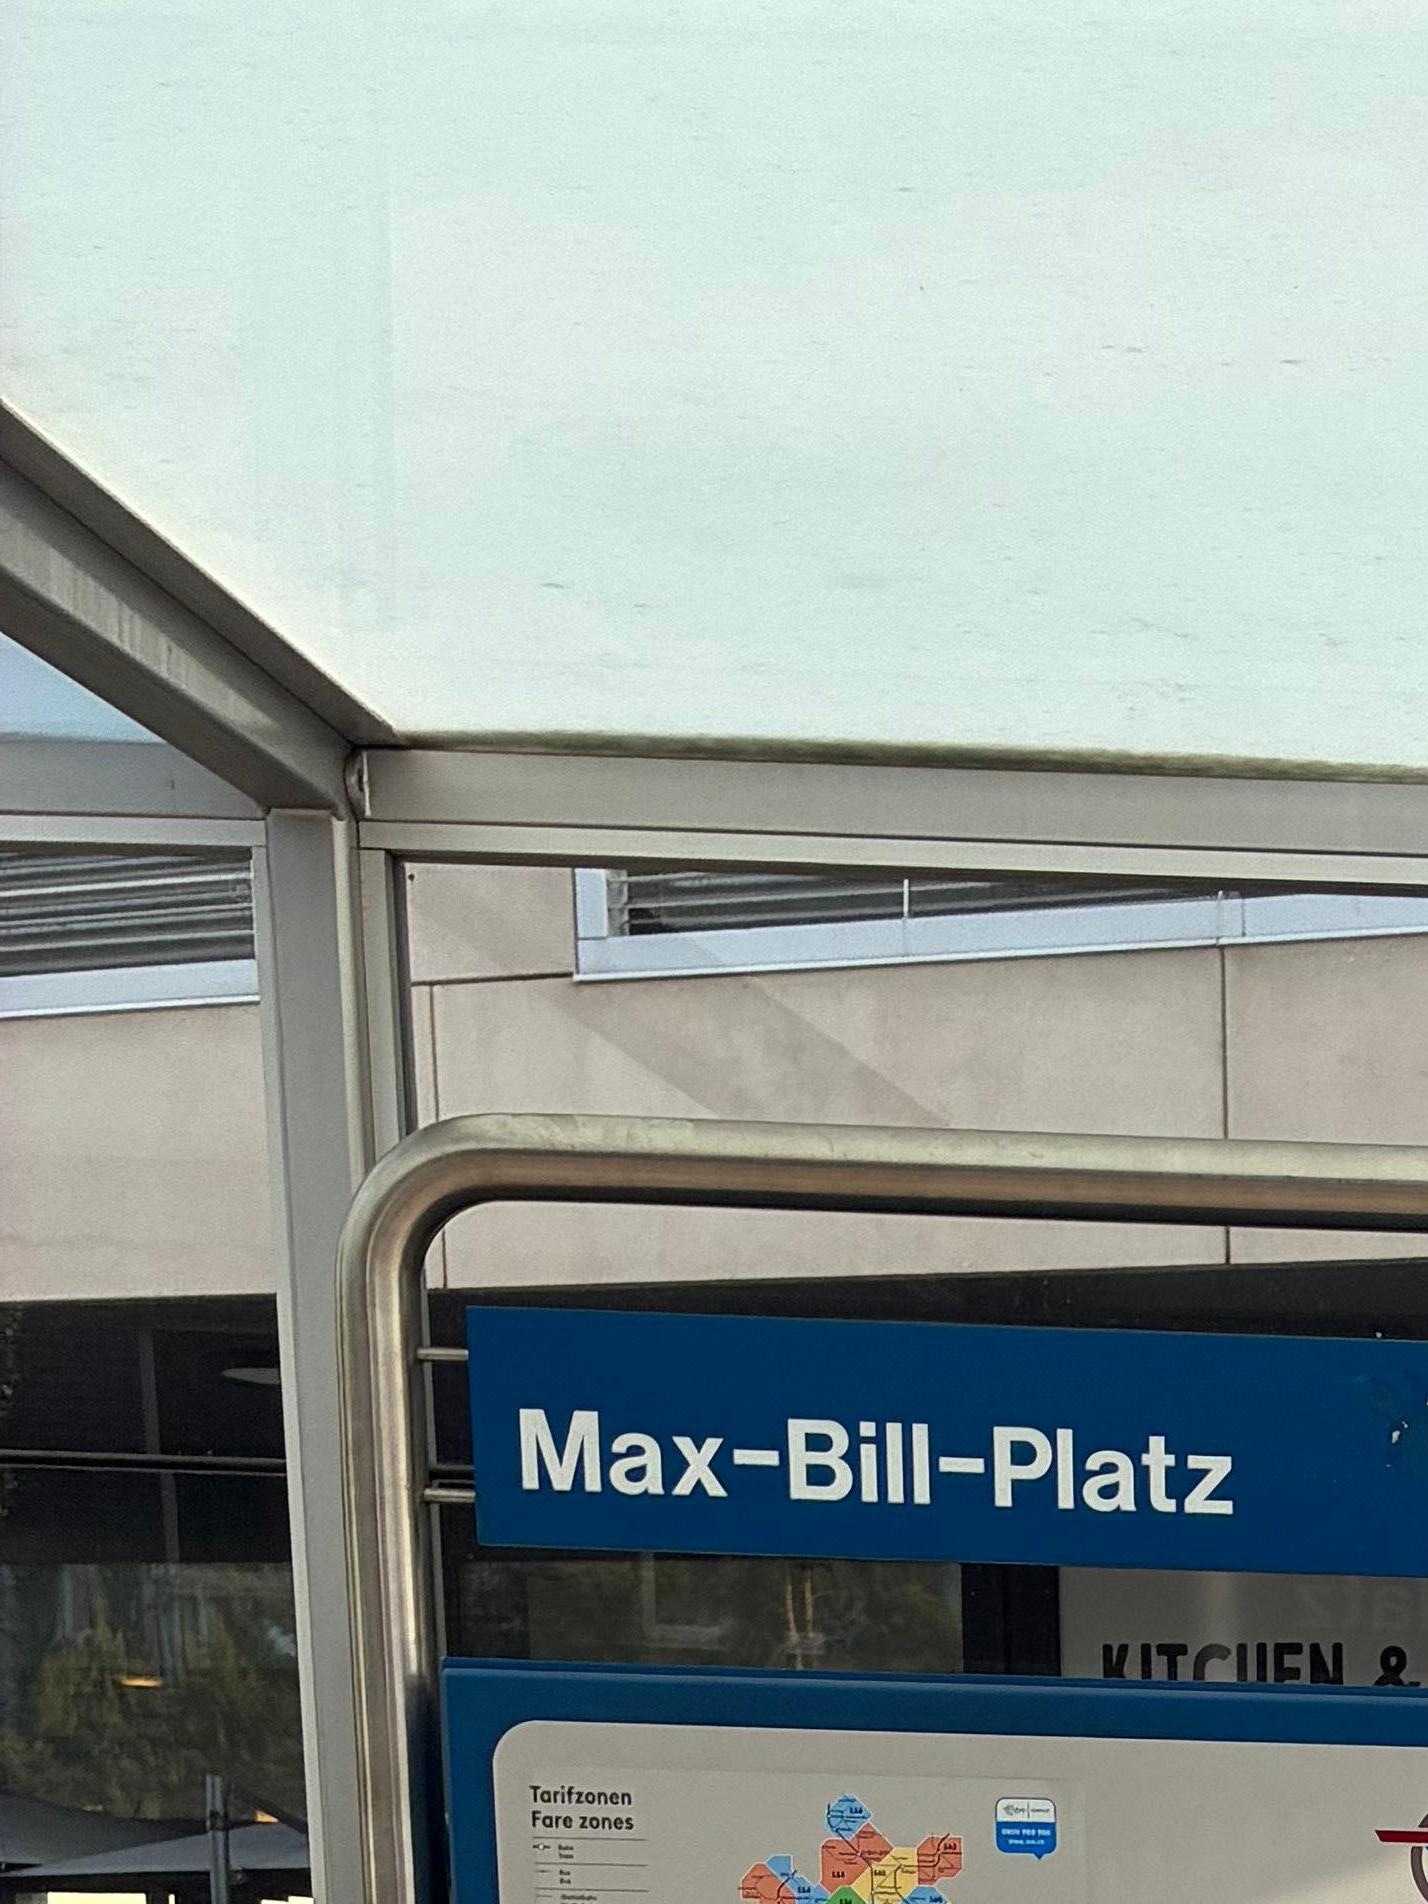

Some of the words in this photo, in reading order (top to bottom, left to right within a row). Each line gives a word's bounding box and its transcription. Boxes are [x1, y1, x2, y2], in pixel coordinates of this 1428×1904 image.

[519, 1408, 1234, 1515] Max-Bill-Platz
[529, 1785, 633, 1806] Tarifzonen
[531, 1810, 573, 1829] Fare
[579, 1815, 635, 1831] zones
